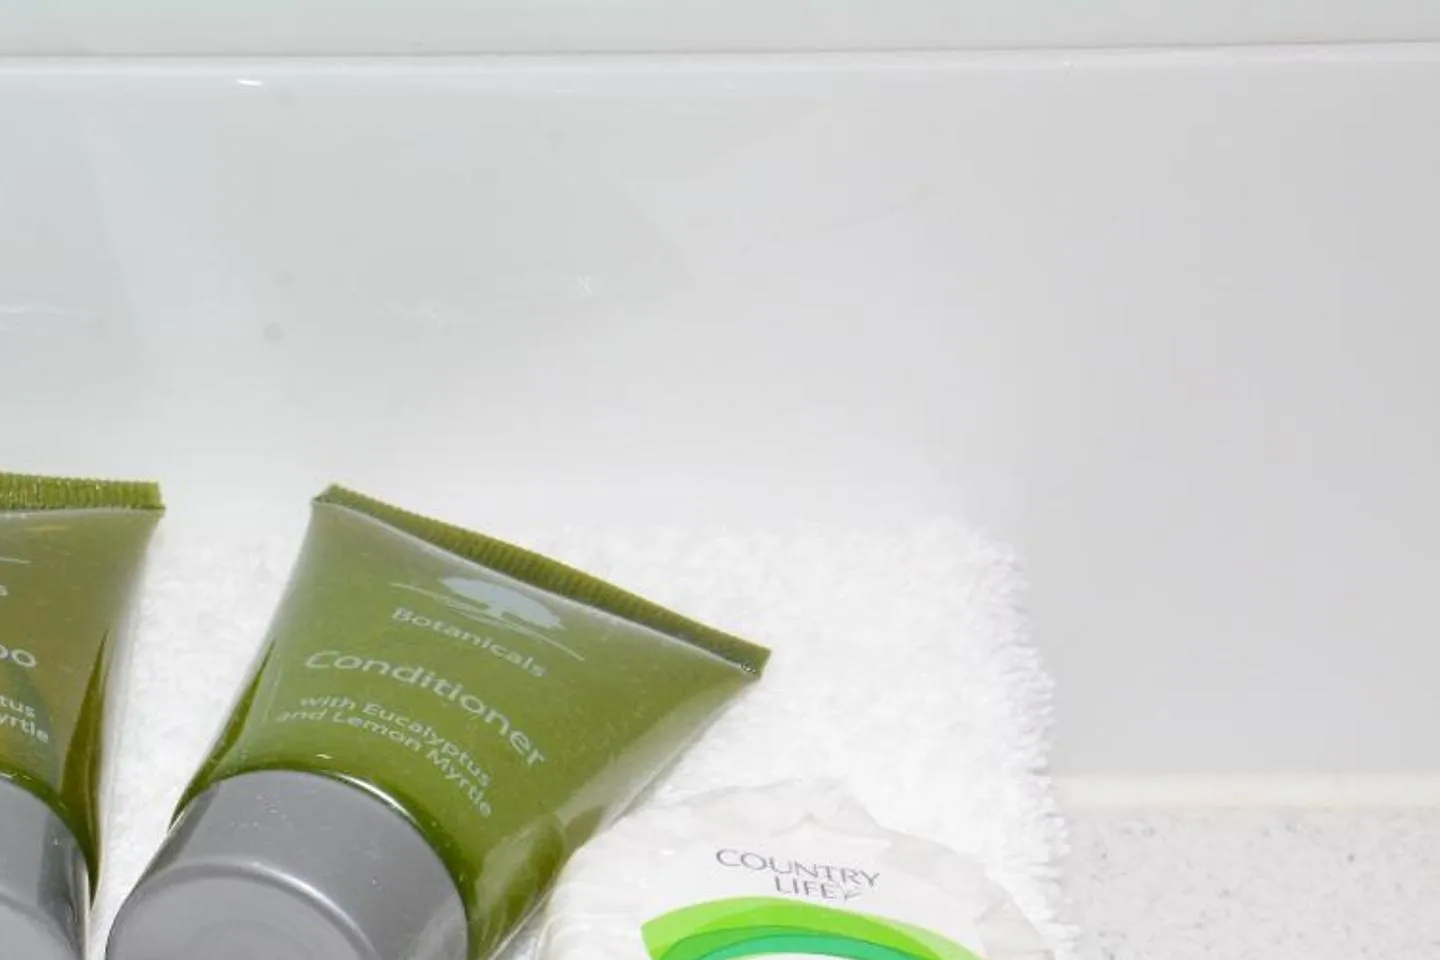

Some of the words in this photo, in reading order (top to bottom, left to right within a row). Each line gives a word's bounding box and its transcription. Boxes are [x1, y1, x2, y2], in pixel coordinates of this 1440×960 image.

[392, 607, 547, 677] Botanicals
[300, 695, 357, 711] with
[362, 701, 493, 787] Eucalyptus
[305, 650, 546, 767] Conditioner
[277, 707, 326, 722] and
[332, 711, 421, 751] Lemon
[426, 749, 493, 817] Myrtle
[715, 848, 880, 888] COUNTRY
[774, 876, 836, 900] LIFE
